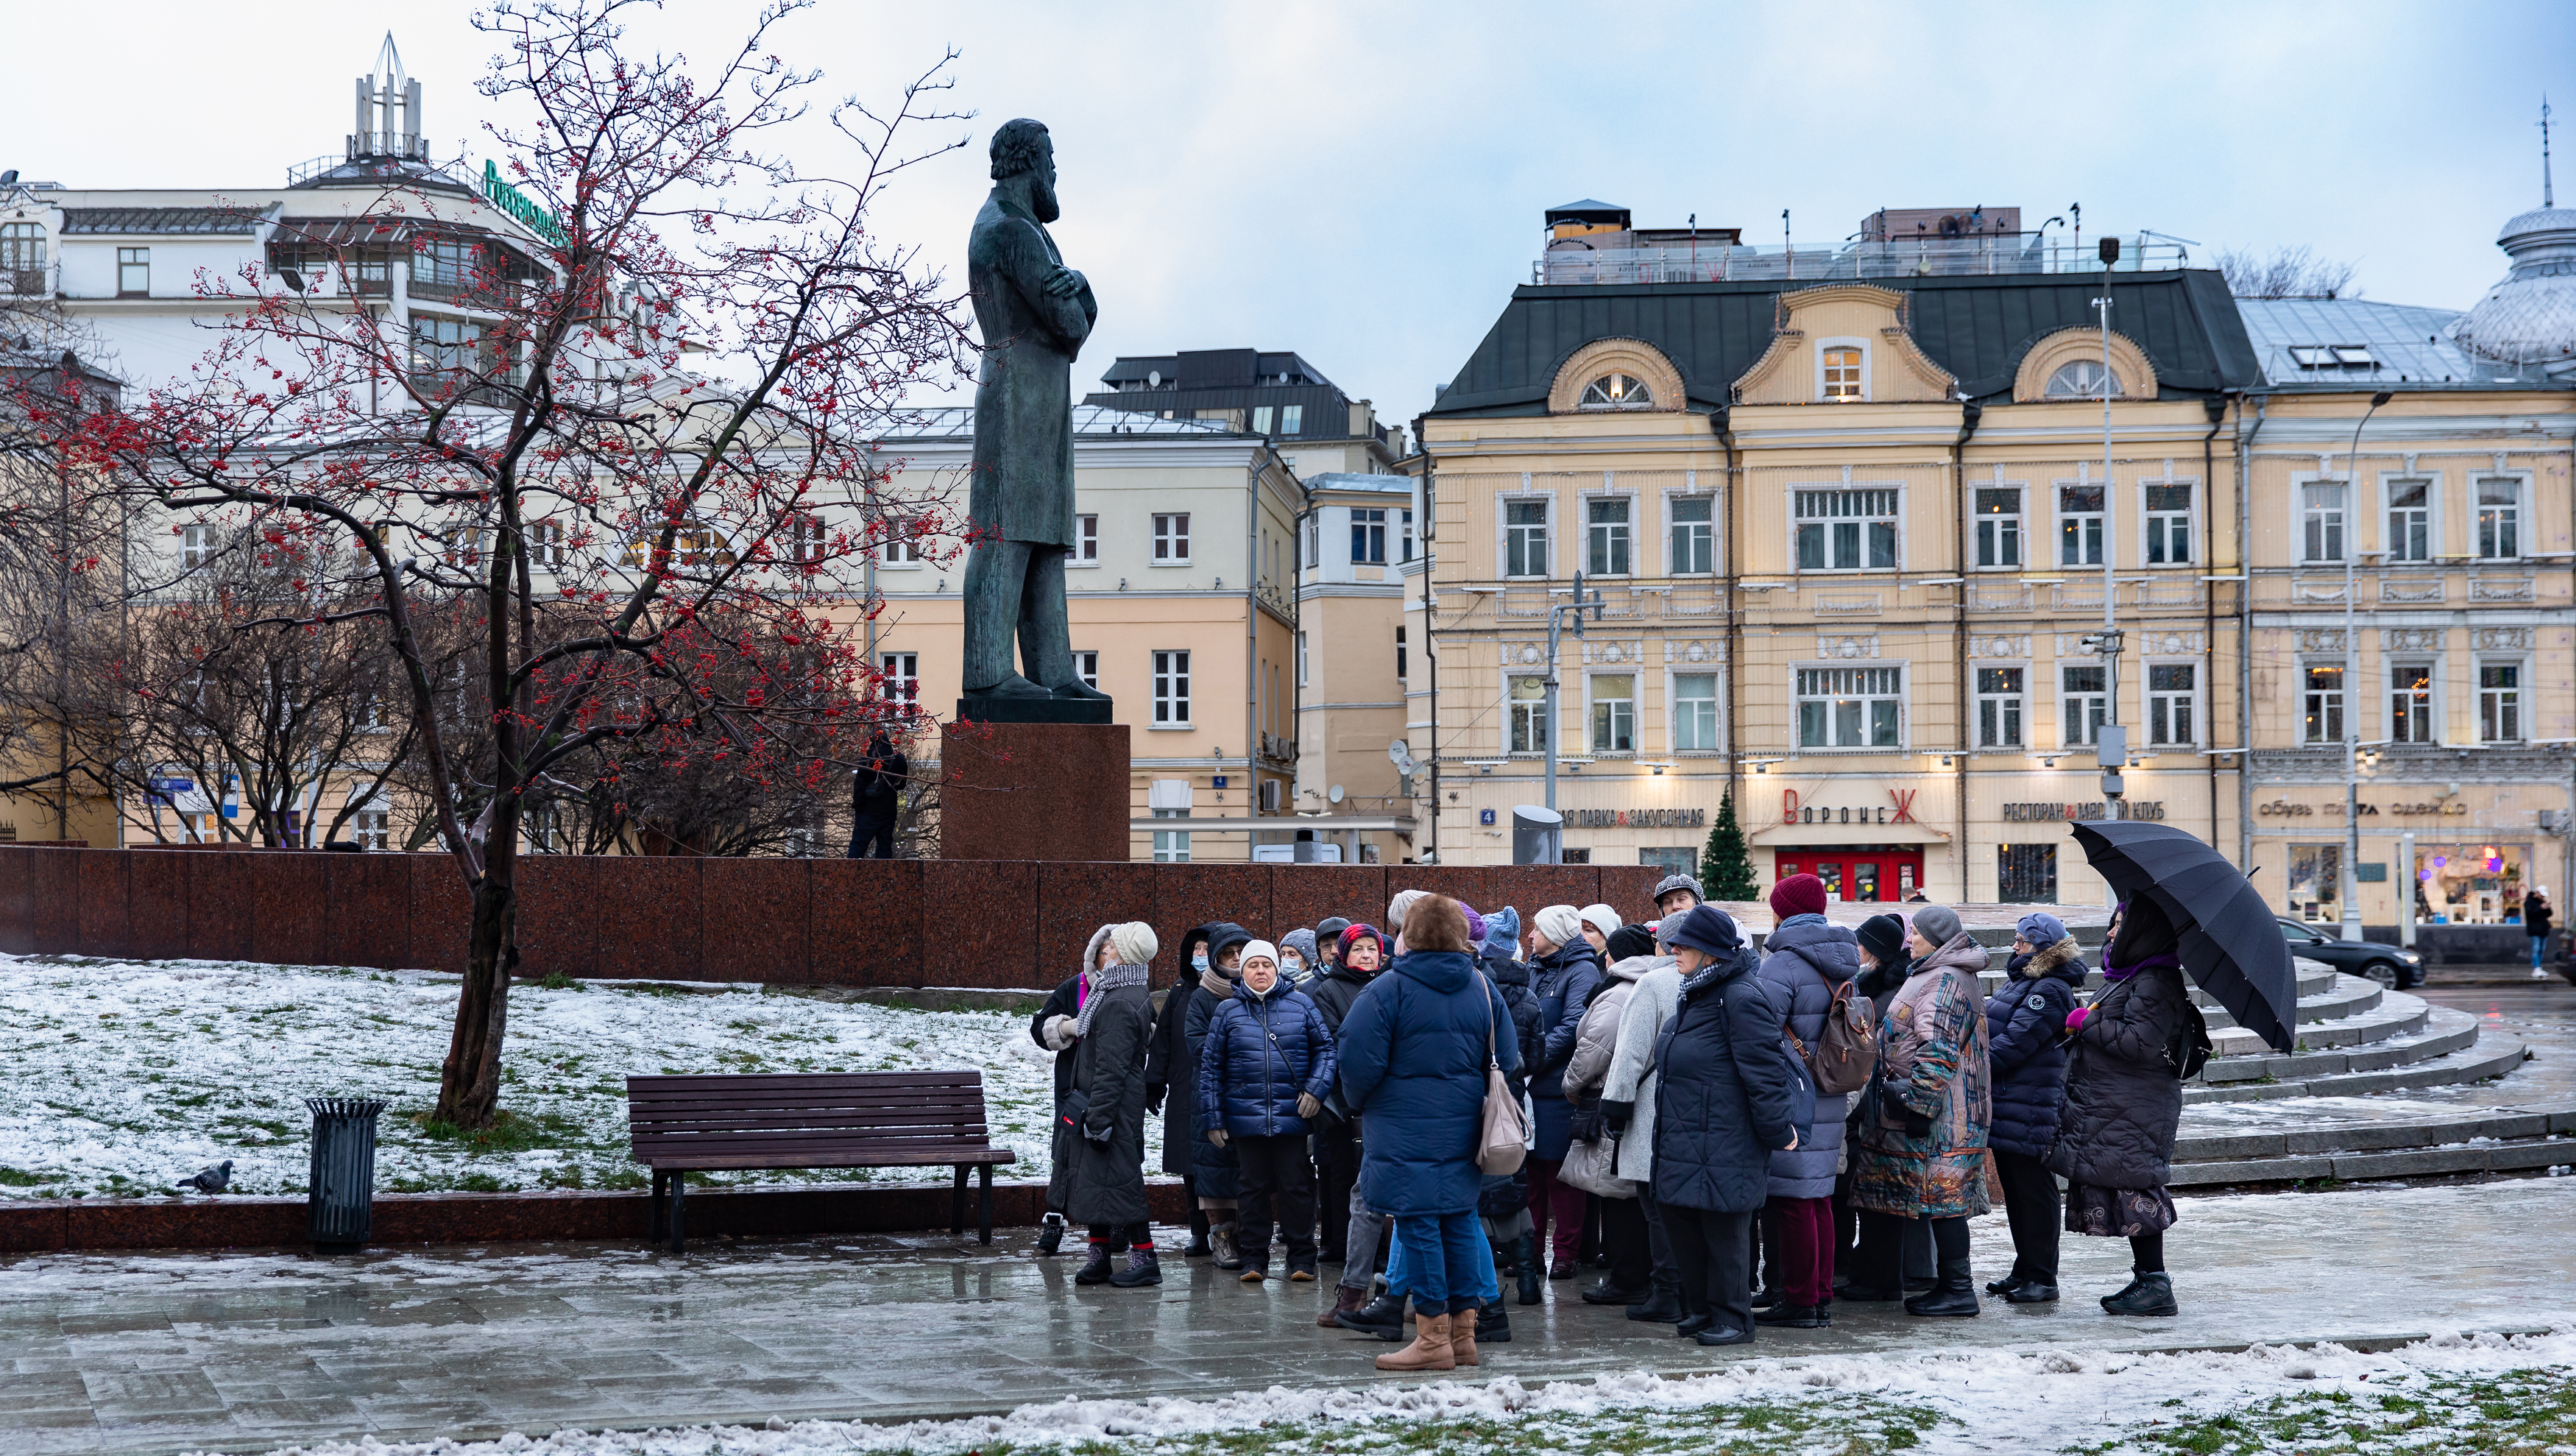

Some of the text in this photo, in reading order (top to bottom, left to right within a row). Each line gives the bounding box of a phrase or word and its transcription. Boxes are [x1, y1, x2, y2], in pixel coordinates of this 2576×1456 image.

[1484, 812, 1492, 822] 4
[1579, 809, 1616, 827] ЛАВКА
[1628, 808, 1705, 827] ЗАКУСОЧНАЯ
[2003, 802, 2063, 821] РЕСТОРАН
[2131, 801, 2165, 820] КЛУБ
